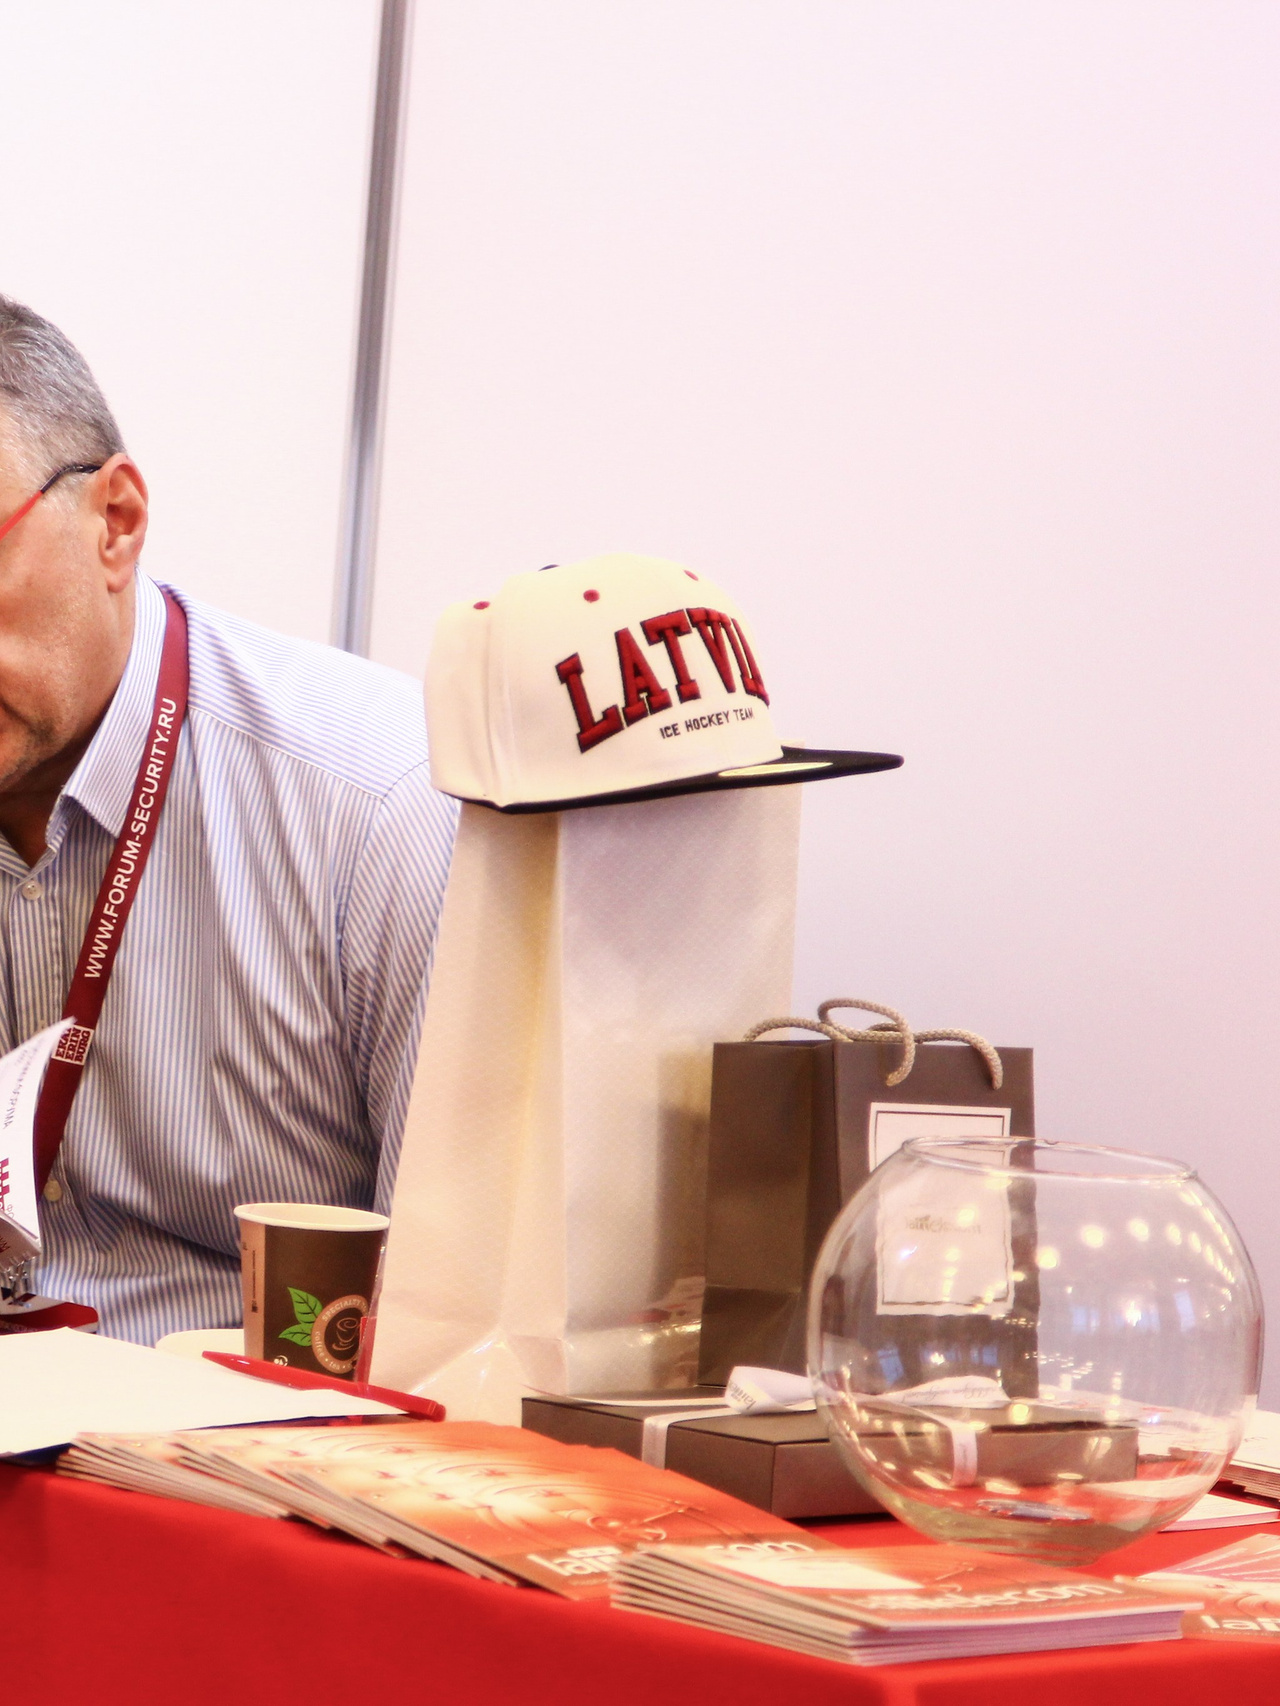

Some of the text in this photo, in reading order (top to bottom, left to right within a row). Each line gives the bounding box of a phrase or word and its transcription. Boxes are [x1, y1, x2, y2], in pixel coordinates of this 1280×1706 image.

[659, 707, 754, 739] ICE HOCKEY TEAM
[84, 697, 177, 979] WWW.FORUM-SECURITY.RU
[64, 1028, 82, 1060] ERIN
[74, 1030, 91, 1063] BURG
